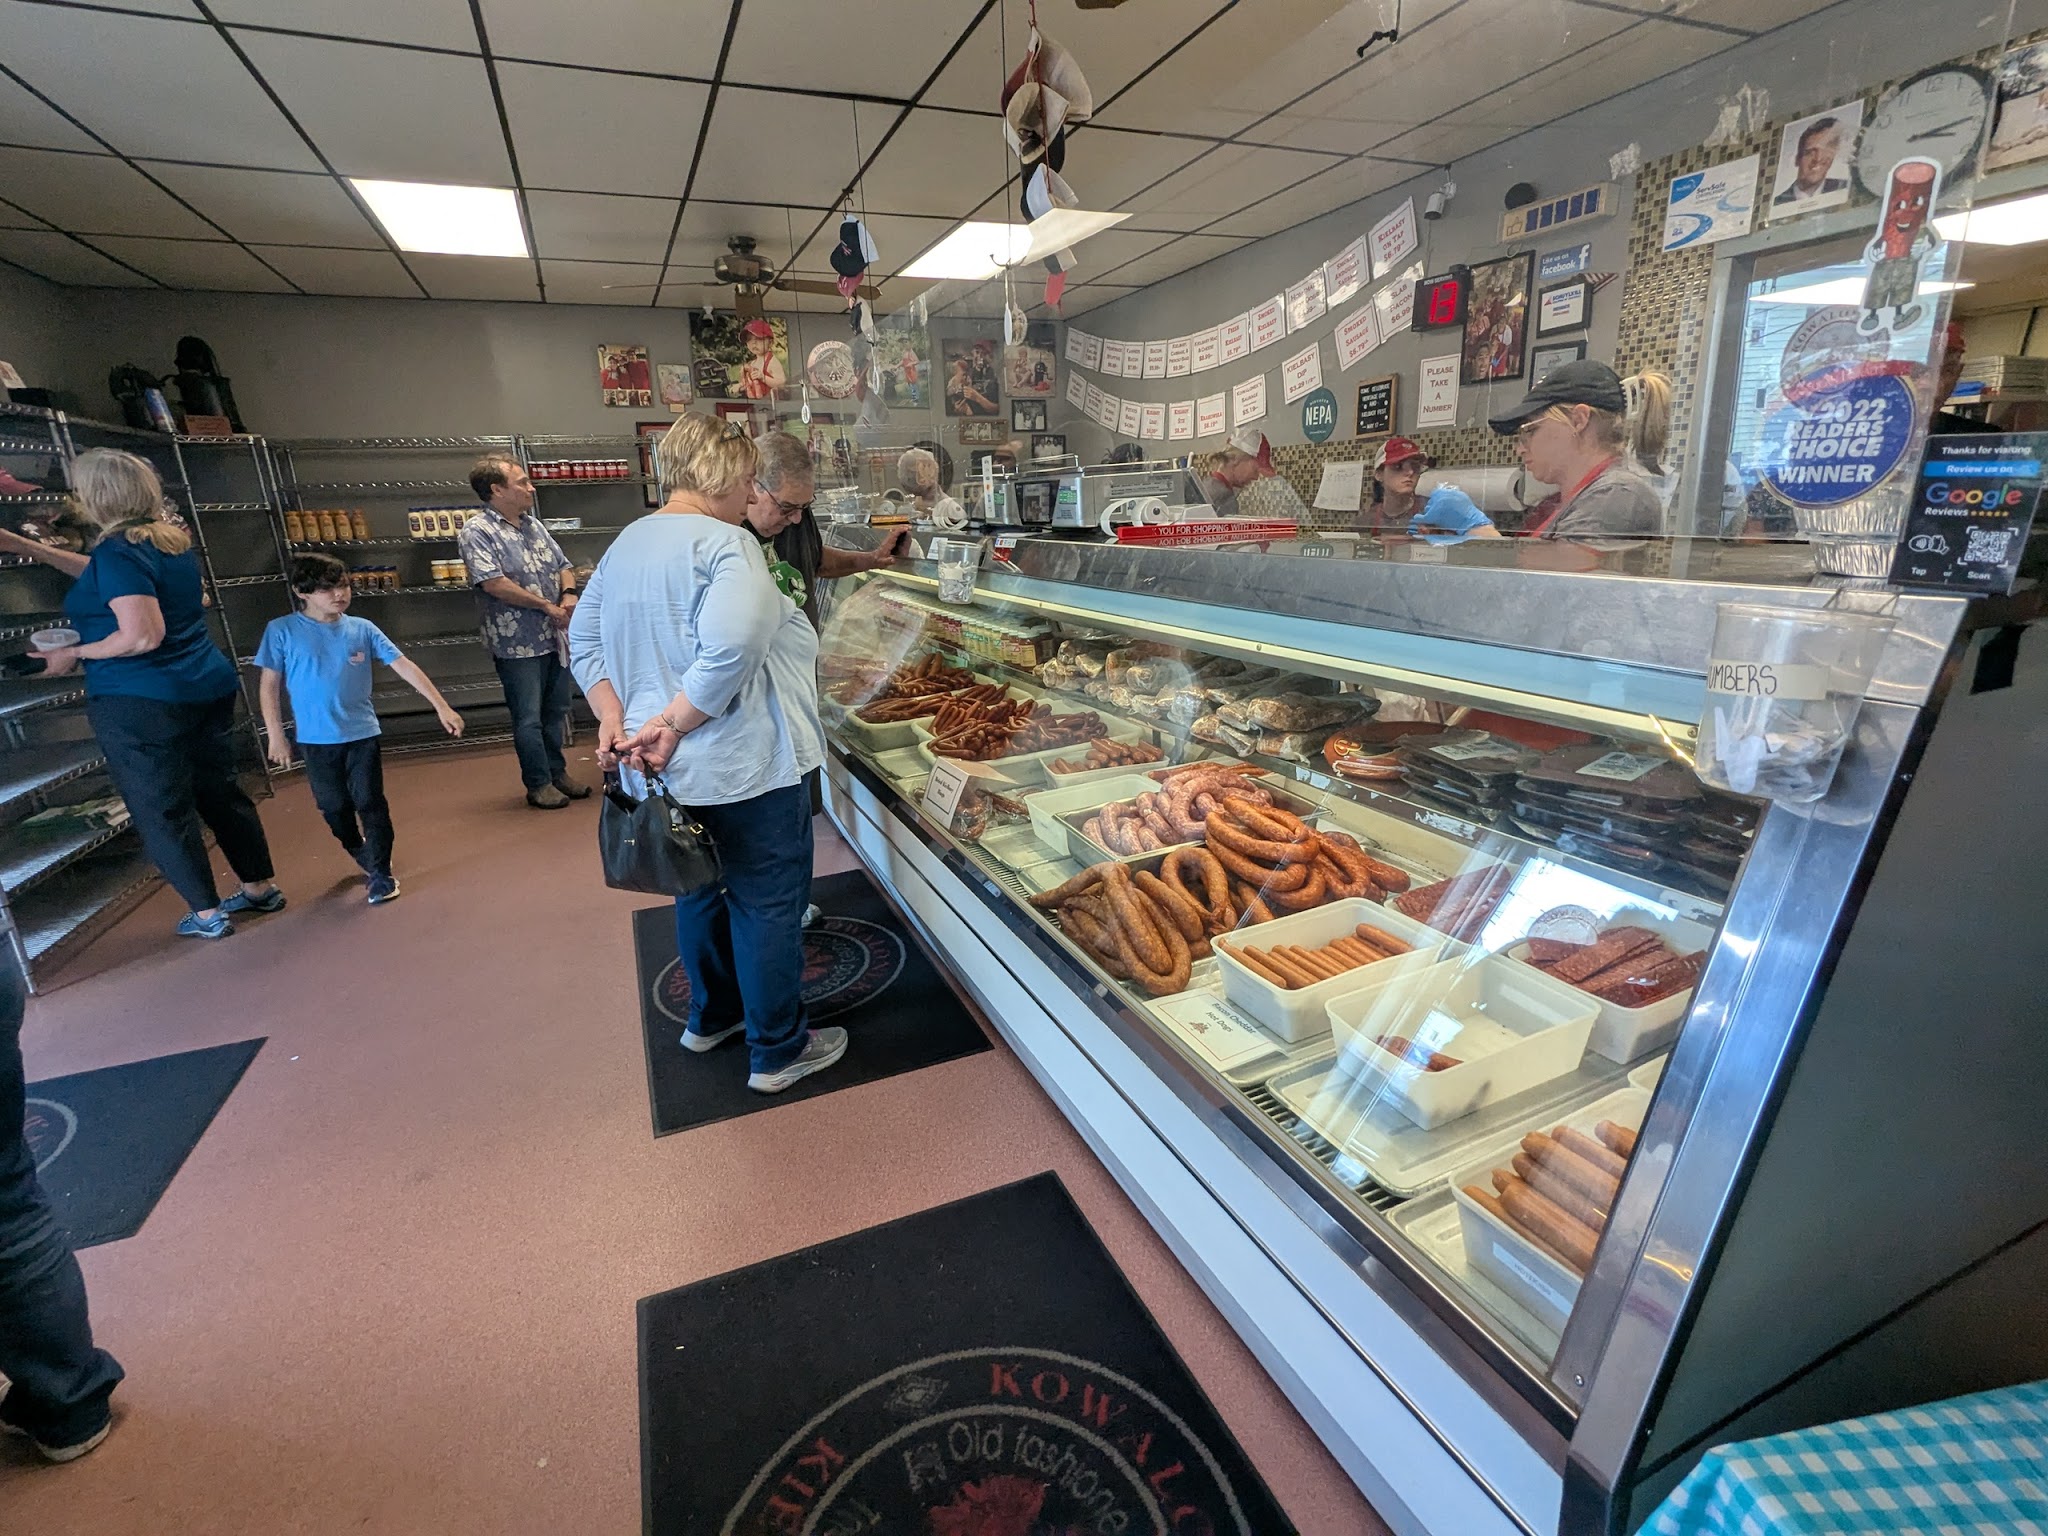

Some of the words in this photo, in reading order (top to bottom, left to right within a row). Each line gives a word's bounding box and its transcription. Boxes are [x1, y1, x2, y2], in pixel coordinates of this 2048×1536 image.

[1697, 181, 1726, 194] ServSafe
[1541, 260, 1576, 276] facebook
[1542, 256, 1553, 265] Like
[1390, 284, 1408, 298] SLAB
[1428, 281, 1458, 323] 13
[1343, 315, 1367, 336] SMOKED
[1345, 326, 1369, 347] SAUSAGE
[1286, 352, 1316, 374] KIELBASY
[1296, 368, 1308, 379] DIP
[1426, 365, 1454, 377] PLEASE
[1430, 379, 1449, 388] TAKE
[1434, 392, 1442, 400] A
[1422, 404, 1453, 414] NUMBER
[1818, 397, 1887, 424] 2022
[1789, 435, 1885, 459] CHOICE
[1942, 446, 1977, 455] Thanks
[1978, 445, 1993, 455] for
[1777, 463, 1876, 484] WINNER
[1946, 465, 1983, 473] Review
[1926, 482, 2023, 510] Google
[1924, 507, 1968, 517] Reviews
[1158, 527, 1175, 535] YOU
[1176, 526, 1192, 534] FOR
[1193, 524, 1229, 533] SHOPPING
[1230, 523, 1249, 531] WITH
[1911, 566, 1927, 576] Tap
[1967, 571, 1991, 580] Scan
[1707, 664, 1777, 696] UMBERS
[1206, 1011, 1220, 1021] Hot
[1216, 1020, 1234, 1033] Dogs
[1212, 1003, 1231, 1017] Bacon
[1229, 1015, 1257, 1034] Cheddar
[947, 1420, 1003, 1462] Old
